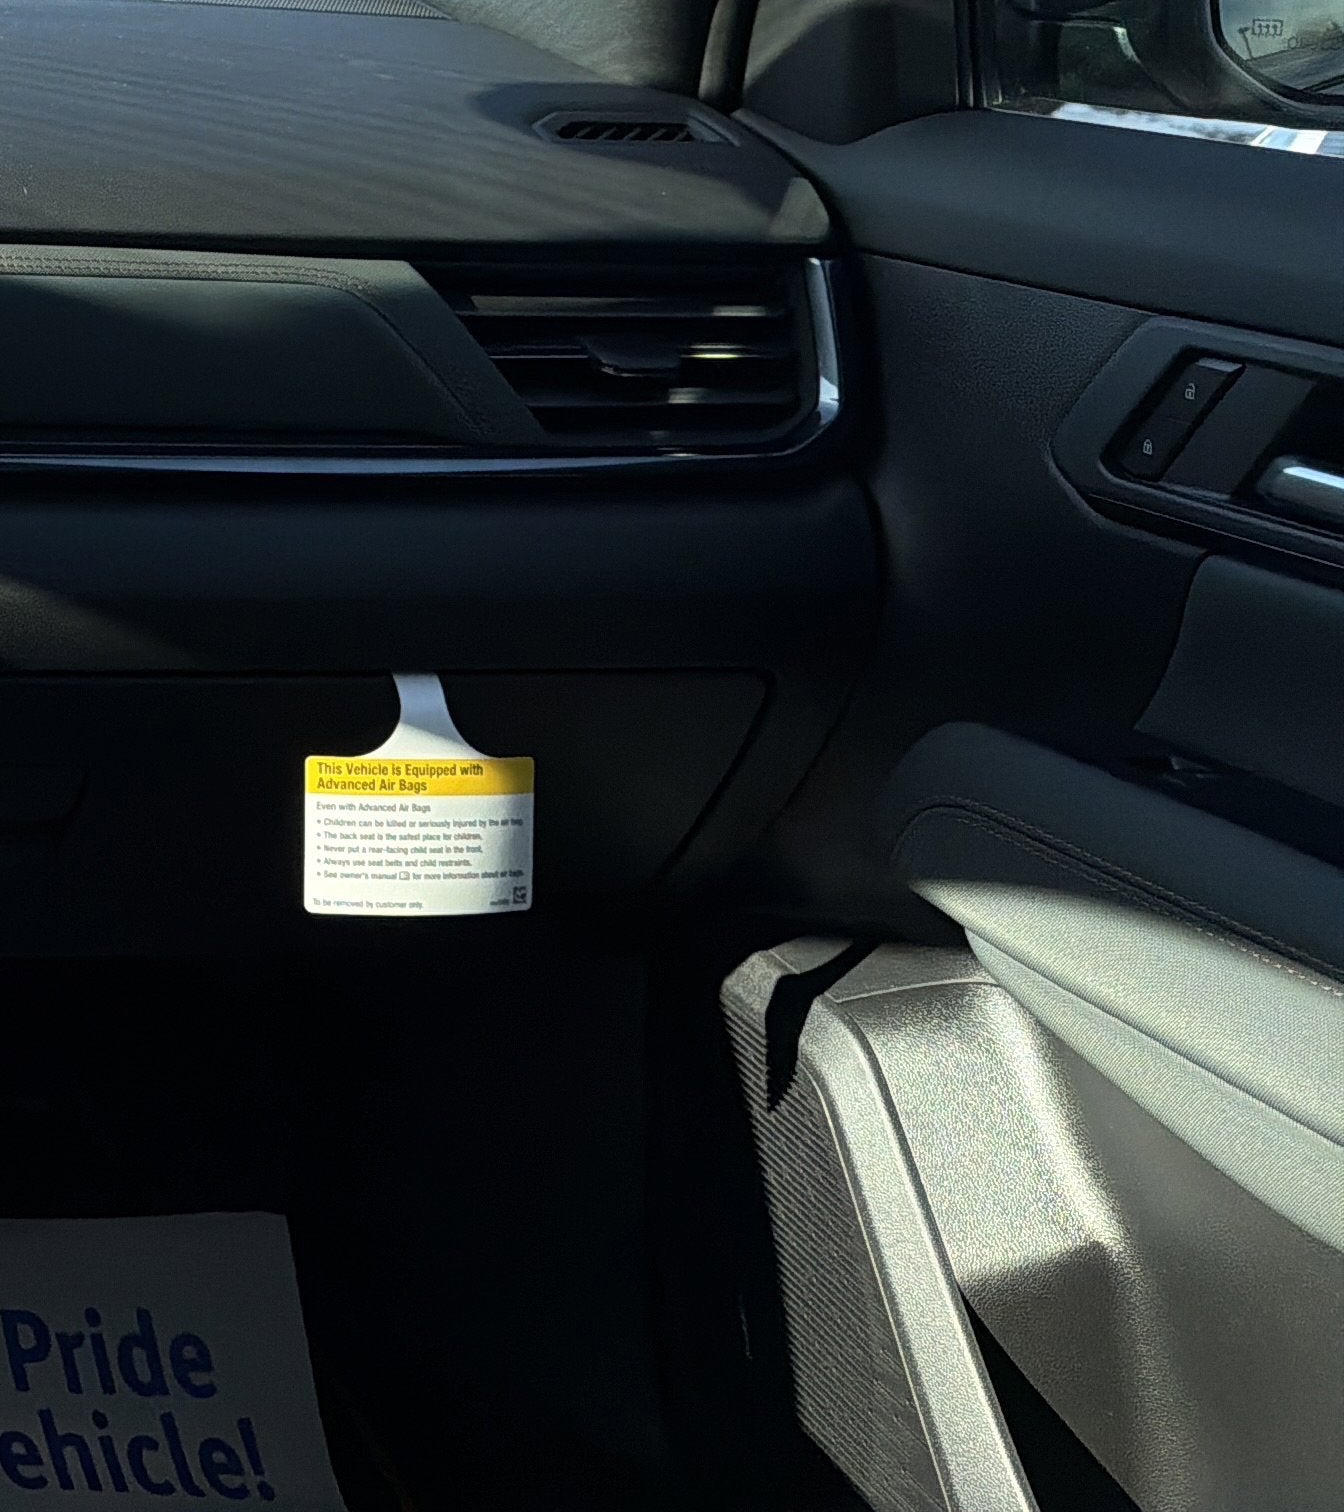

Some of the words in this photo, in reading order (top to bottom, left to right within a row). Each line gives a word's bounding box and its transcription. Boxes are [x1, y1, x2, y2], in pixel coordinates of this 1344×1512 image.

[317, 761, 342, 775] This
[346, 762, 388, 776] Vehicle
[392, 763, 401, 776] is
[405, 763, 456, 779] Equipped
[460, 763, 484, 776] with
[317, 777, 375, 791] Advanced
[379, 778, 396, 791] Air
[399, 779, 427, 794] Bags
[316, 801, 336, 810] Even
[339, 802, 356, 811] with
[358, 803, 397, 812] Advanced
[399, 803, 409, 812] Air
[412, 803, 431, 813] Bags
[324, 818, 356, 826] Children
[324, 831, 337, 839] The
[0, 1307, 218, 1399] Pride
